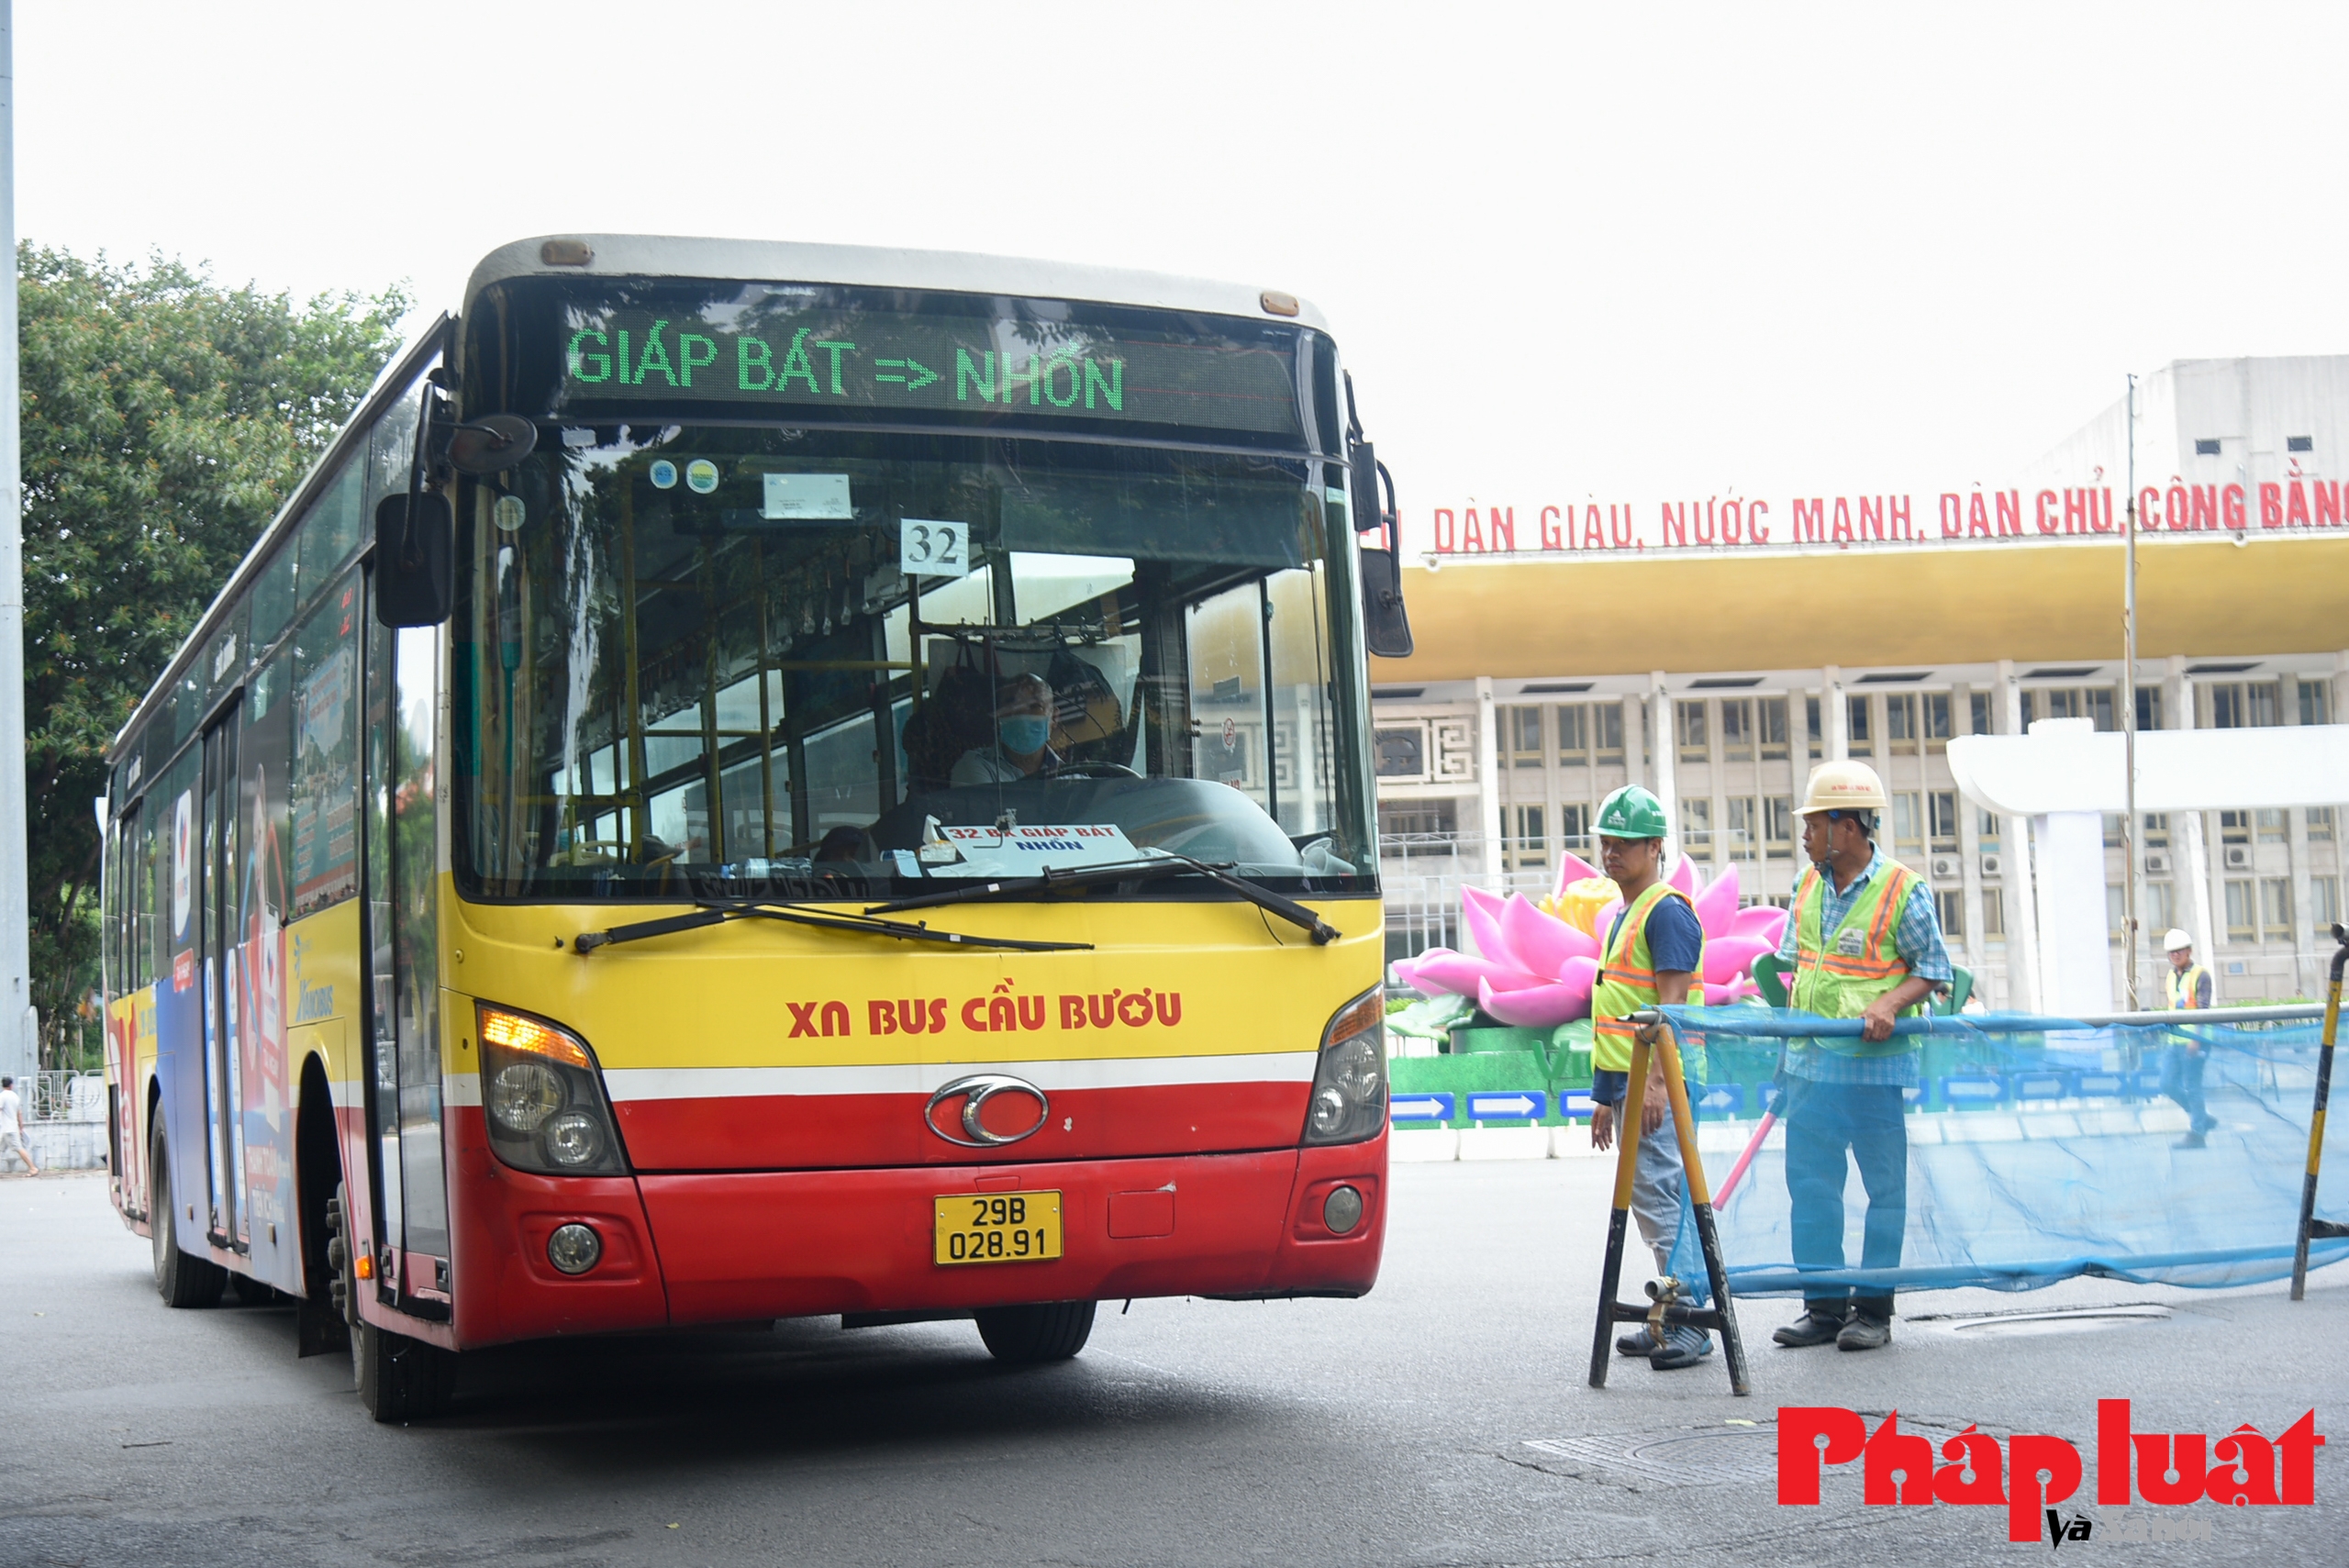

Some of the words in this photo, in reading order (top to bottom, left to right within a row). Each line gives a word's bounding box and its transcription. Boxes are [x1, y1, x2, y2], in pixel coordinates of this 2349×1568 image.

[568, 319, 718, 387] GIÁP
[738, 327, 856, 395] BÁT
[956, 339, 1123, 411] NHỔN
[2139, 474, 2247, 532] CÔNG
[2258, 456, 2349, 529] BẰN
[907, 524, 959, 565] 32
[948, 828, 984, 840] 32
[1020, 826, 1070, 838] GIÁP
[1074, 825, 1117, 837] BÁT
[867, 998, 948, 1036] BUS
[961, 977, 1046, 1032] CẦU
[1059, 987, 1183, 1030] BƯƠU
[971, 1196, 1026, 1227] 29B
[949, 1228, 1046, 1260] 028.91
